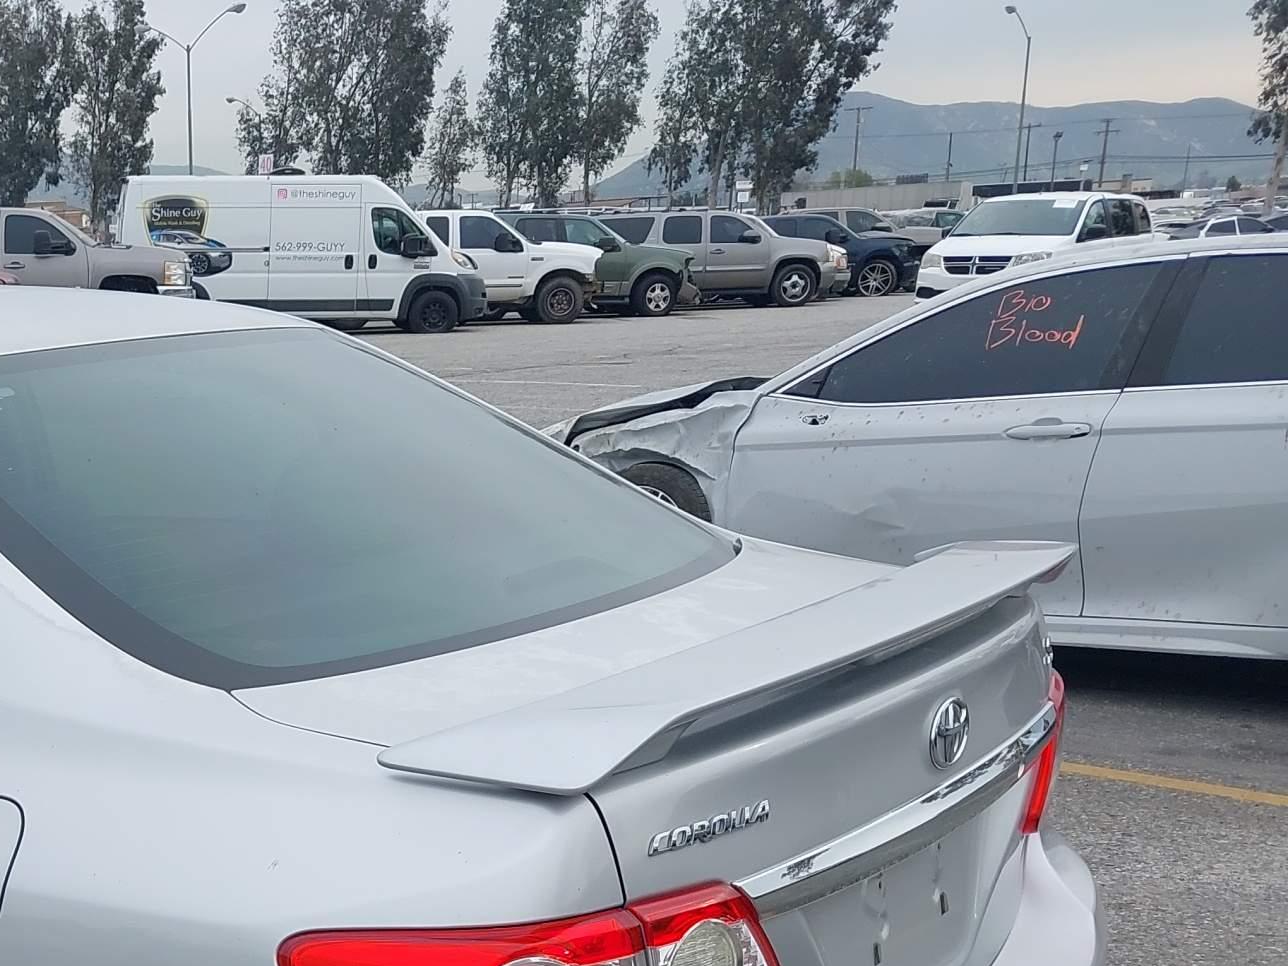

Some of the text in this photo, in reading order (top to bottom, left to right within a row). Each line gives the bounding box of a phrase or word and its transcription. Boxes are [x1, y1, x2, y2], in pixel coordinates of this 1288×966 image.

[151, 207, 203, 222] Shine Guy
[274, 241, 345, 252] 562-999-GUYY
[985, 314, 1085, 351] Blood
[647, 798, 771, 857] COROLLA
